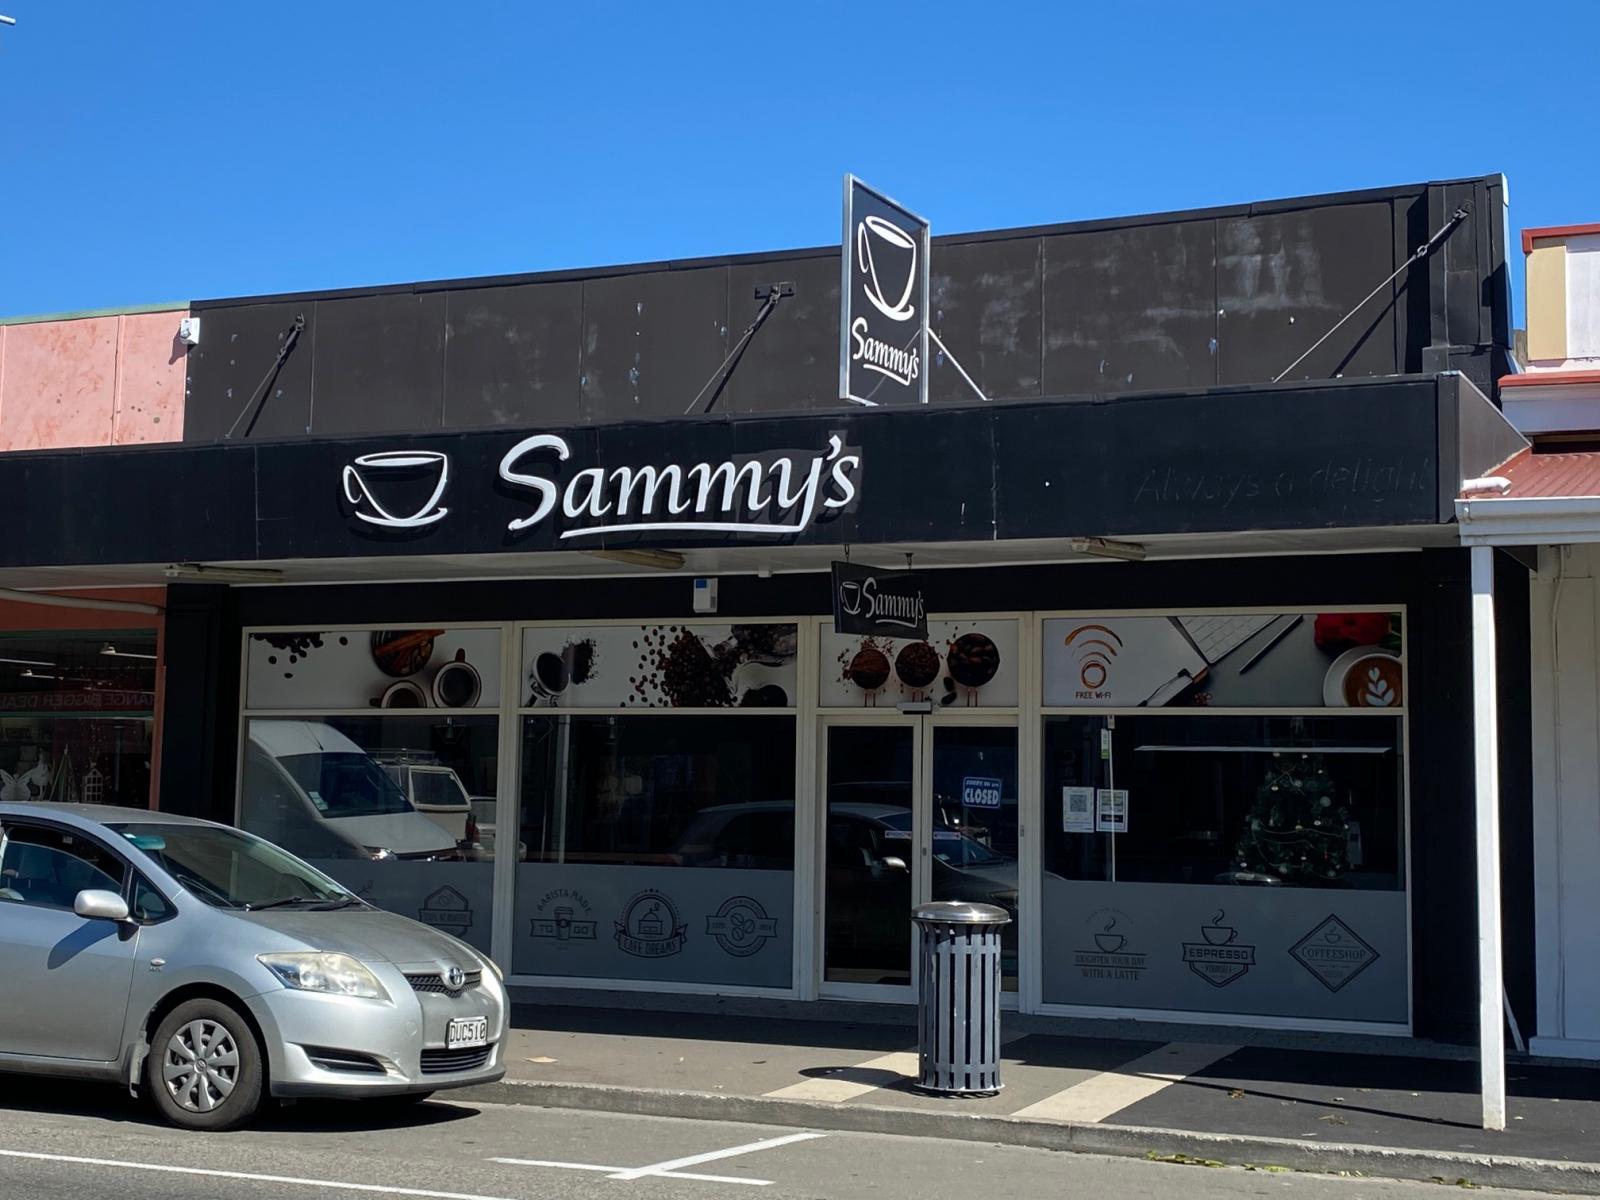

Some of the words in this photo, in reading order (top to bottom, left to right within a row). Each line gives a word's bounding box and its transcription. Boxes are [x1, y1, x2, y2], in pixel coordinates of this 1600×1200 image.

[852, 317, 919, 386] Sammy's
[500, 434, 859, 538] Sammy's
[863, 577, 924, 628] Sammy's
[1075, 691, 1093, 699] FREE
[964, 788, 999, 805] CLOSED
[573, 926, 588, 935] GO
[1189, 948, 1248, 960] ESPRESSO
[1301, 946, 1366, 961] COFFEESHOP
[1081, 968, 1103, 978] WITH
[1115, 970, 1138, 981] LATTE
